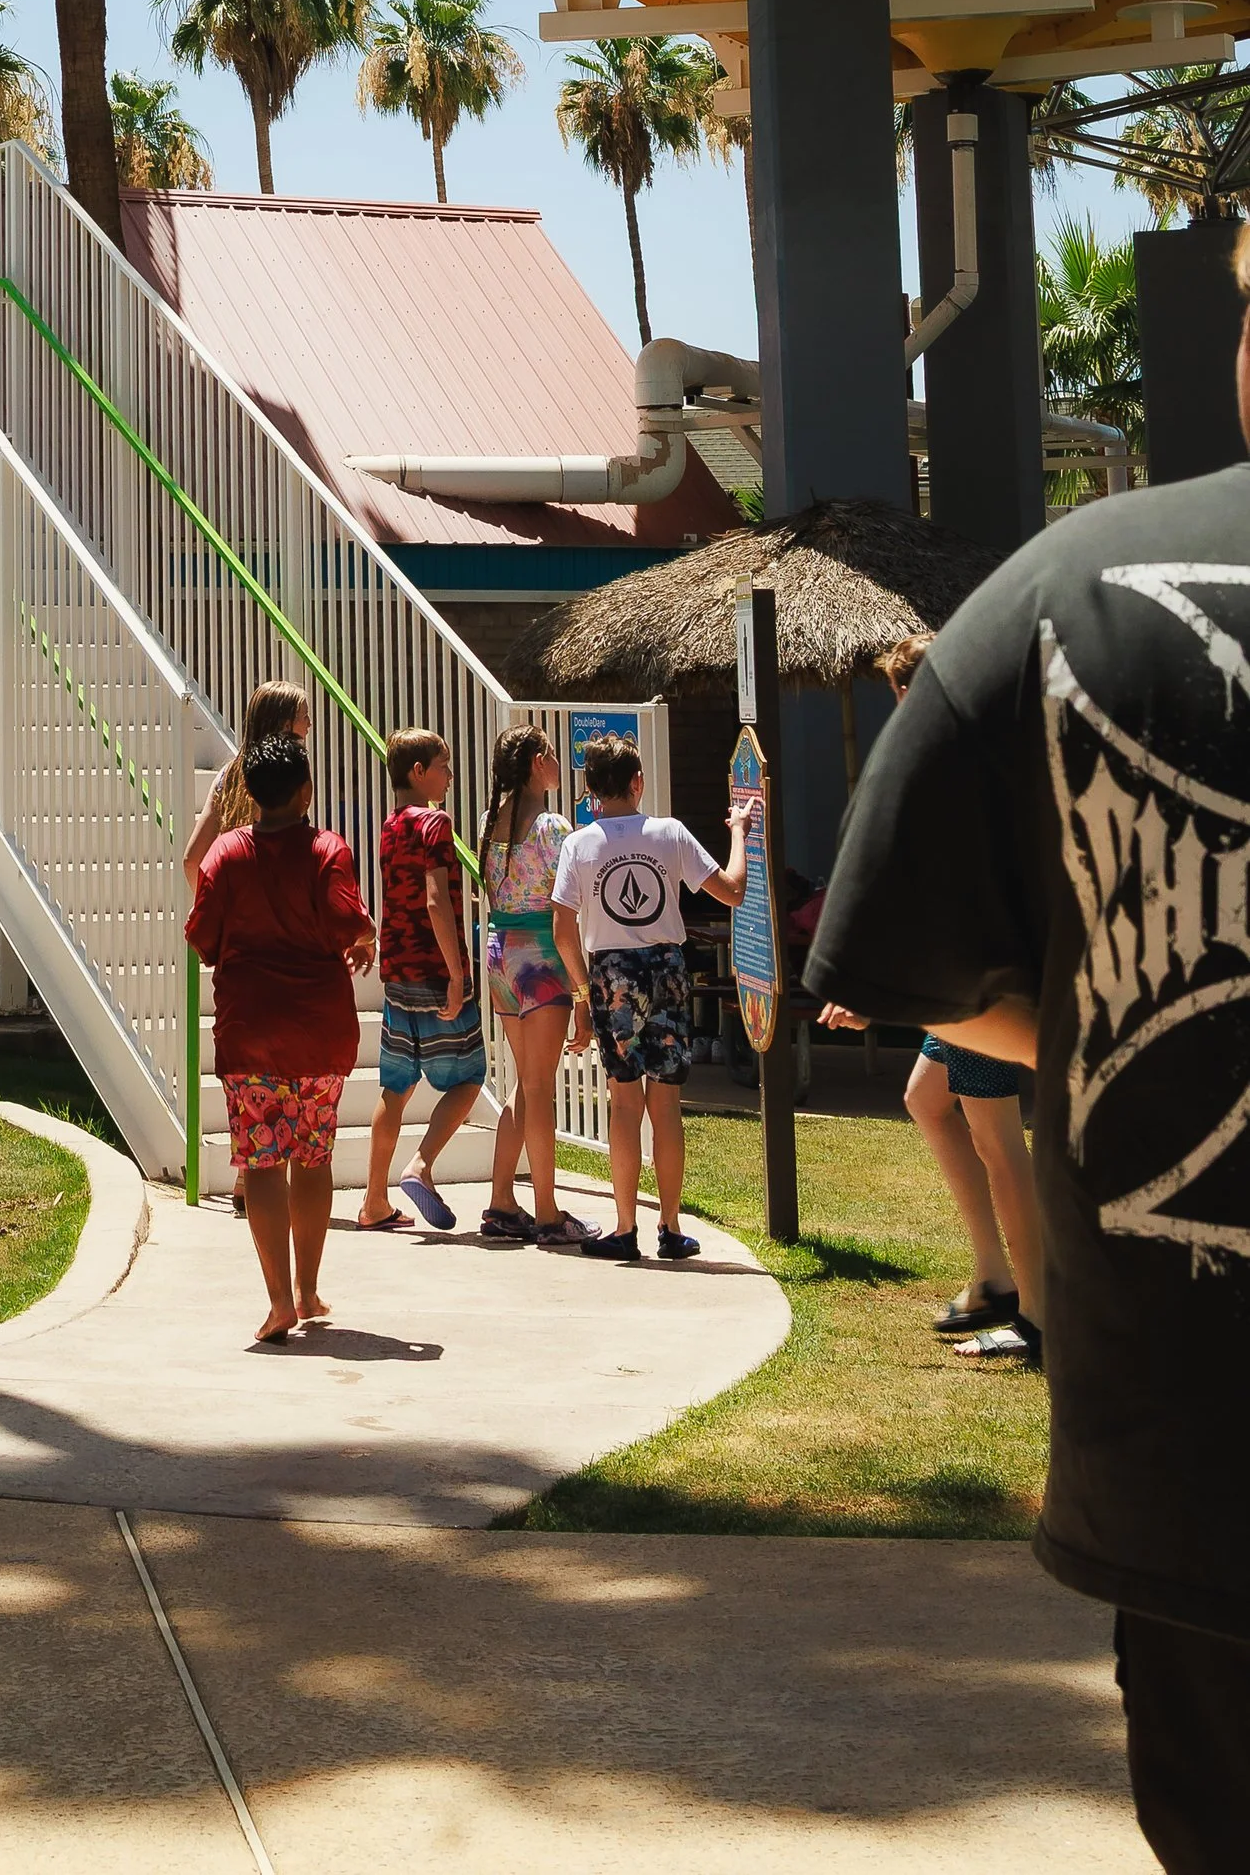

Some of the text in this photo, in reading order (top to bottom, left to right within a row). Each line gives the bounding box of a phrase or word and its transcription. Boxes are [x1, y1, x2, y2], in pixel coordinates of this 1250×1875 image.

[574, 717, 606, 727] DoubleDare
[596, 854, 629, 879] ORIGINAL
[630, 853, 659, 866] STONE
[657, 864, 667, 878] CO.
